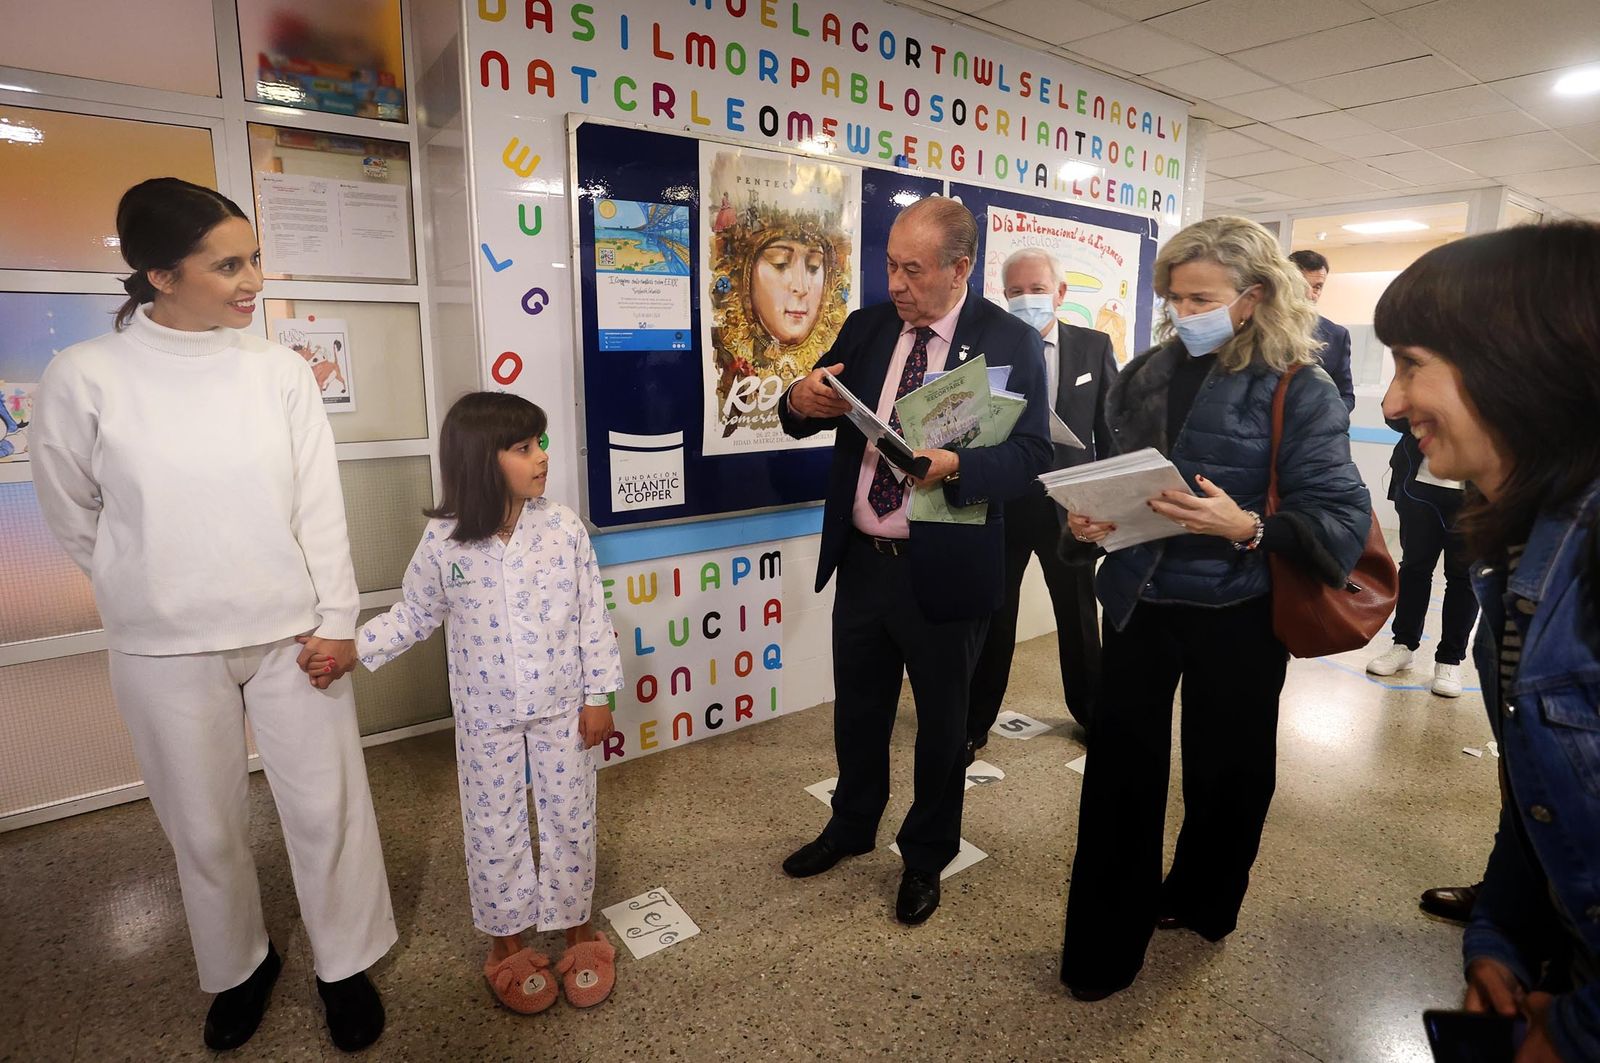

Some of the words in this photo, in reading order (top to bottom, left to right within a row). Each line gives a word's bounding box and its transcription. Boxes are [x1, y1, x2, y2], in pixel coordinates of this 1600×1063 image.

[518, 203, 542, 236] U
[992, 212, 1014, 233] Día
[1016, 213, 1079, 240] Internacional
[480, 242, 514, 273] L
[521, 287, 550, 315] G
[491, 351, 523, 386] O
[618, 478, 679, 494] ATLANTIC
[625, 490, 672, 504] COPPER
